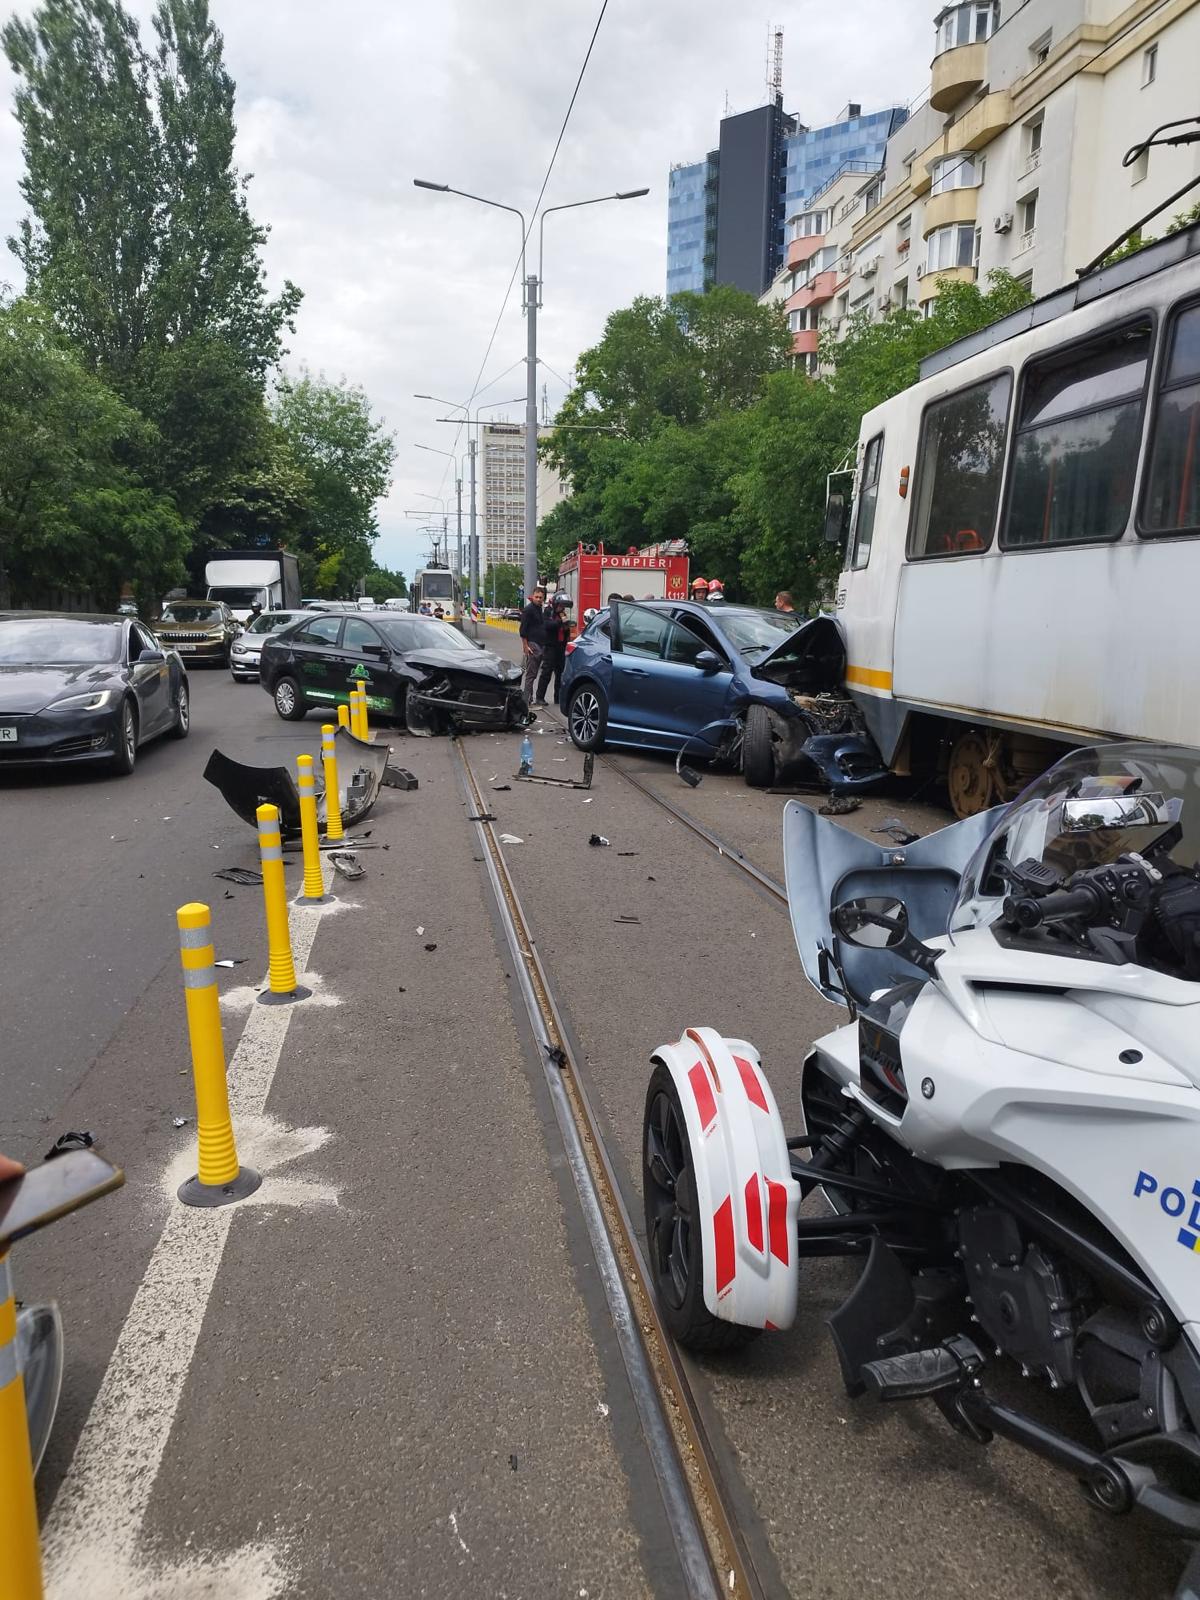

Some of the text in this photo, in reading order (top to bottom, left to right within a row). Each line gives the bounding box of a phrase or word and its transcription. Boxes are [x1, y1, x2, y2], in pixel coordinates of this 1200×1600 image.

[601, 557, 672, 568] POMPIERI
[672, 592, 685, 600] 112
[0, 729, 11, 739] R
